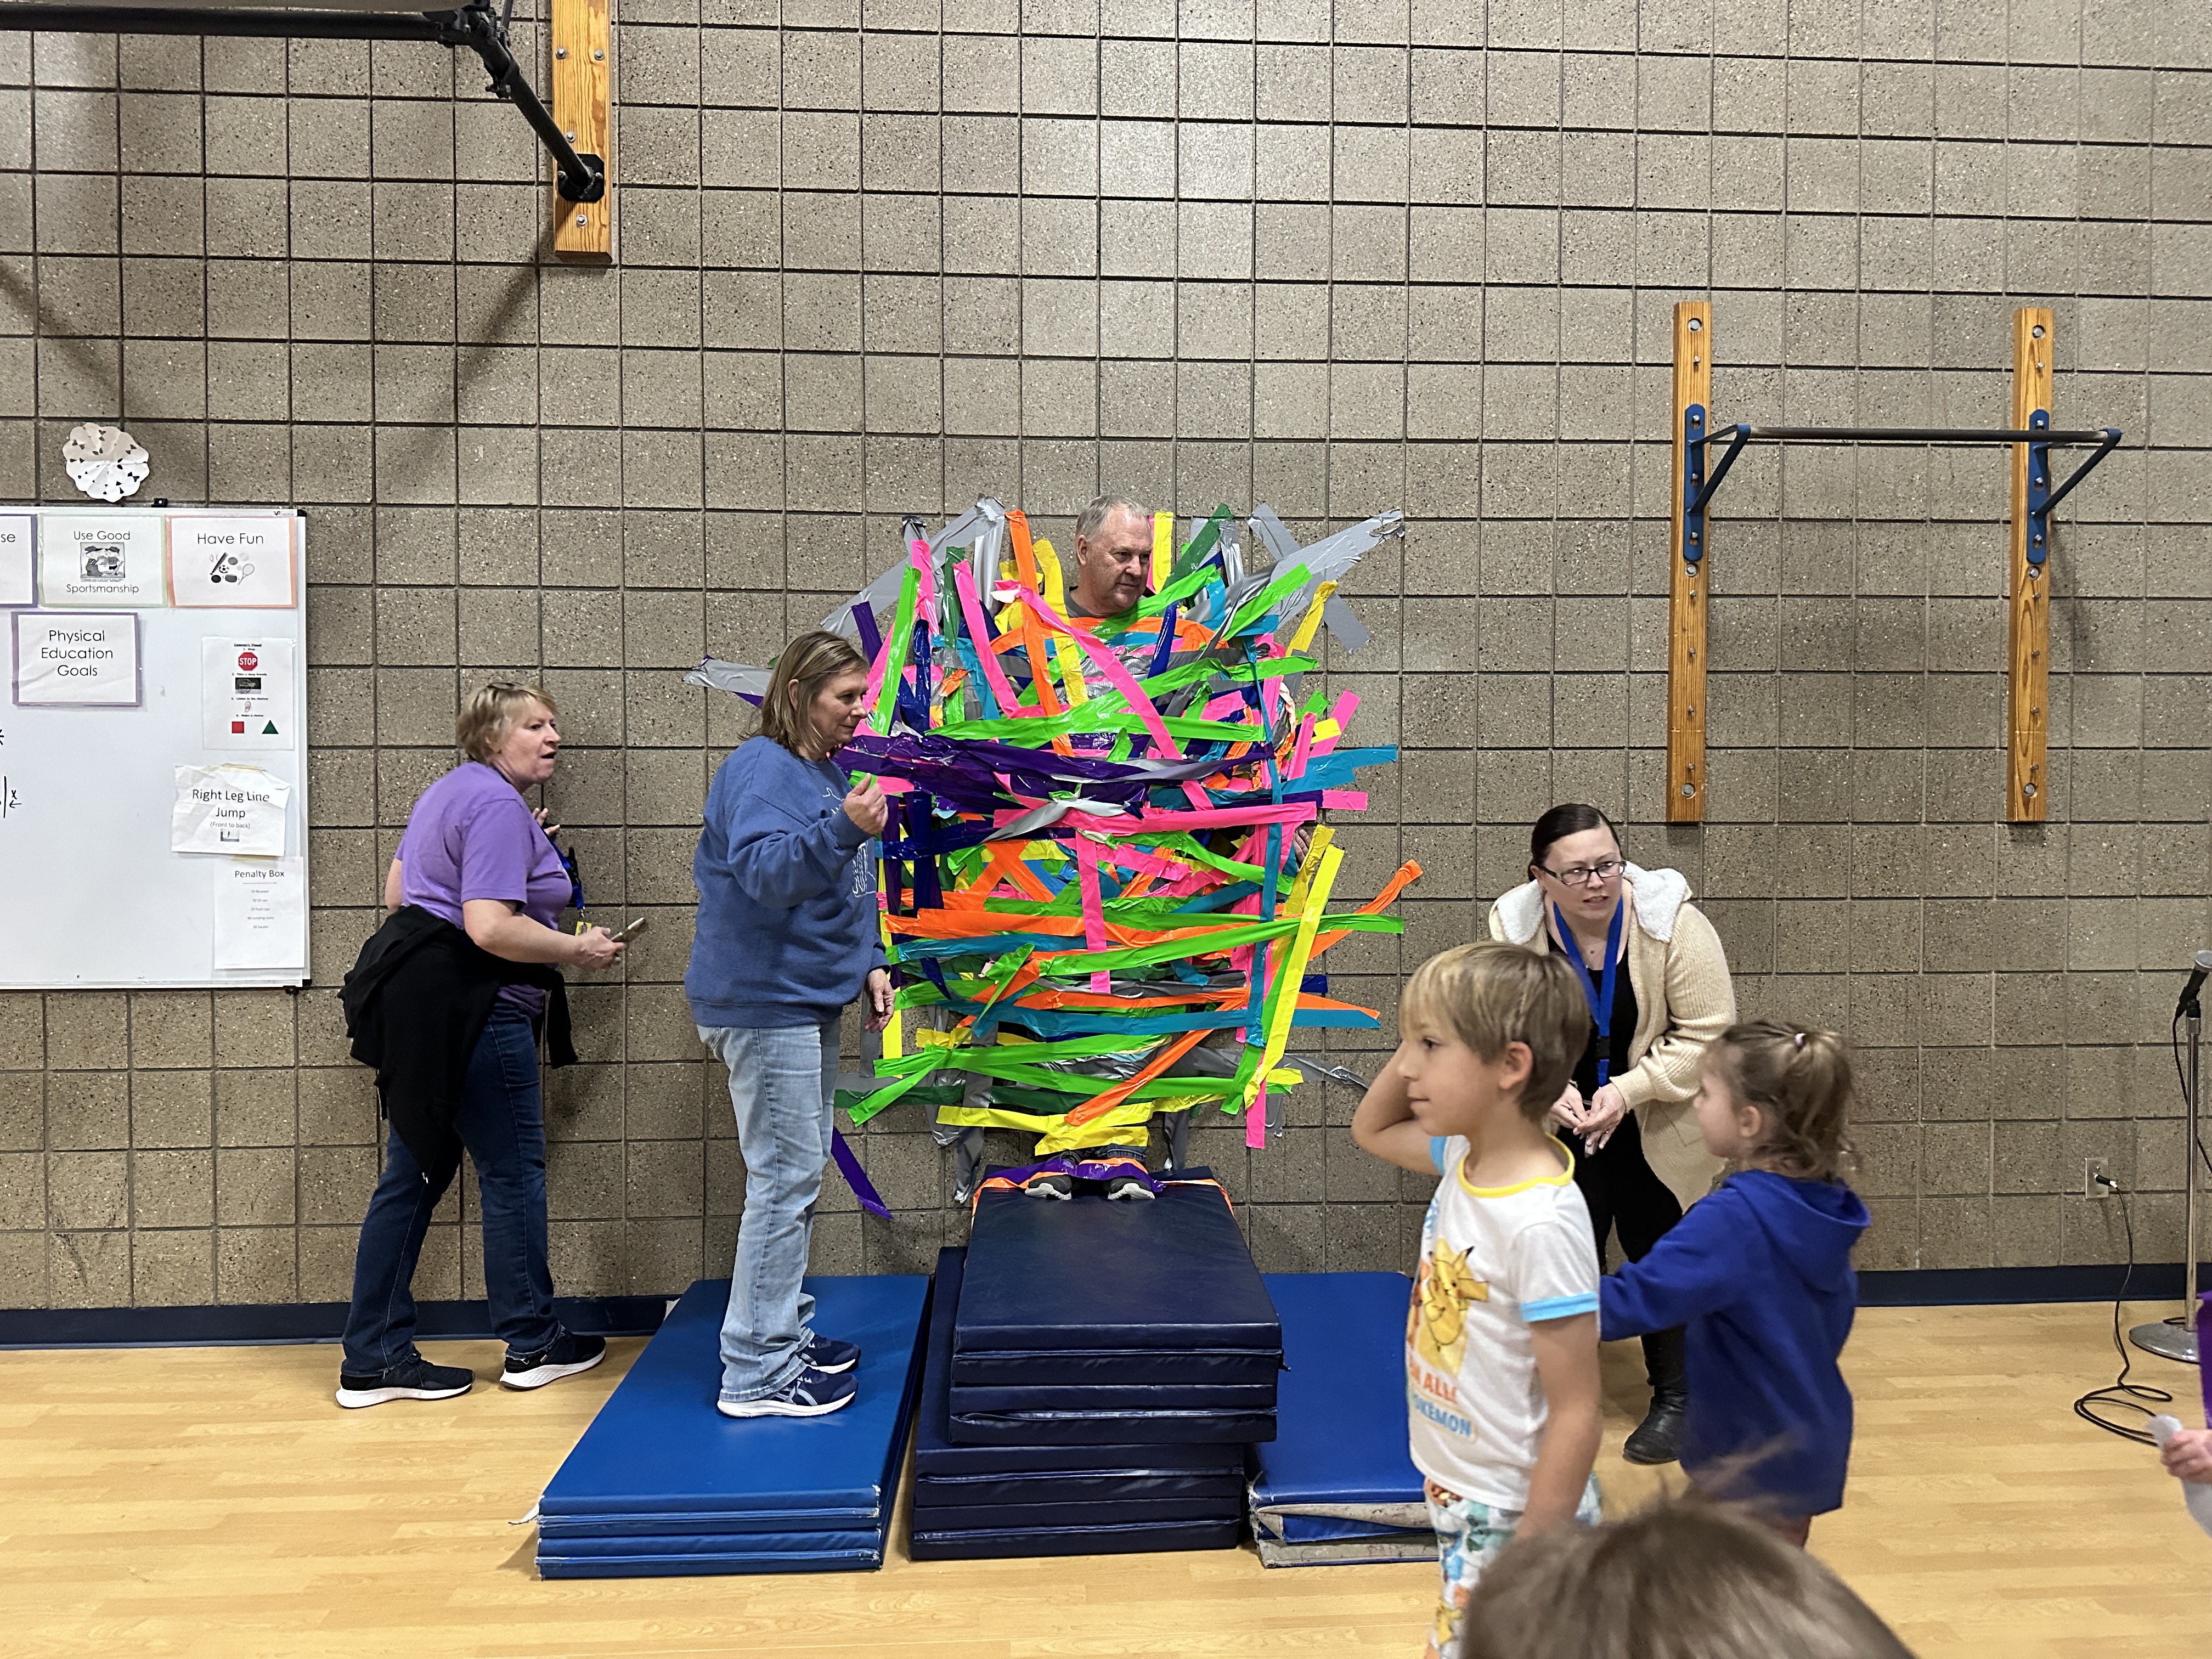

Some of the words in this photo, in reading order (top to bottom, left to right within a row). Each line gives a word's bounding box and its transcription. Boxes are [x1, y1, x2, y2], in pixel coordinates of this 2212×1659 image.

[74, 531, 93, 540] Use
[97, 531, 131, 540] Good
[198, 533, 234, 544] Have
[240, 533, 263, 544] Fun
[66, 584, 139, 595] Sportsmanship
[49, 629, 105, 644] Physical
[41, 647, 113, 659] Education
[239, 657, 257, 666] STOP
[57, 664, 98, 676] Goals
[192, 789, 222, 802] Right
[225, 790, 244, 803] Leg
[246, 791, 270, 802] Line
[216, 807, 246, 820] Jump
[235, 870, 267, 879] Penalty
